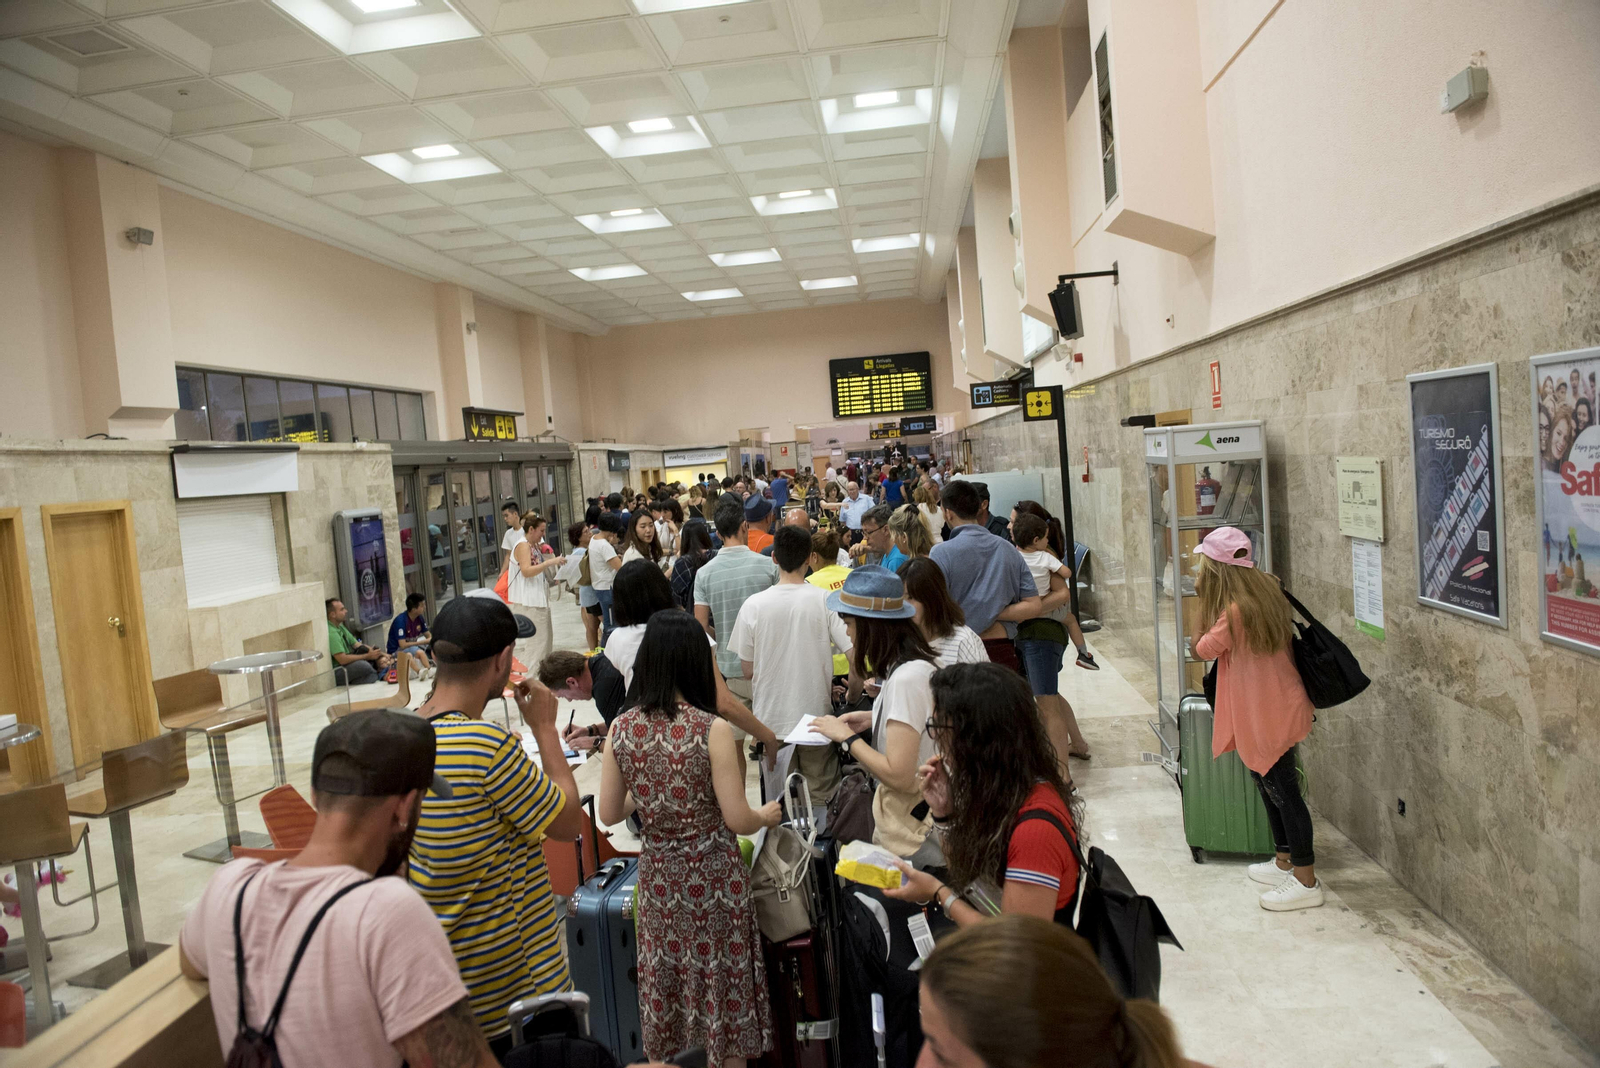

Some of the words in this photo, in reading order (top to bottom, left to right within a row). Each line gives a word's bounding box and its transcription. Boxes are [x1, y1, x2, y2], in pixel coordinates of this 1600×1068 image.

[481, 427, 495, 437] Salida
[1419, 428, 1455, 439] TURISMO
[1216, 436, 1240, 444] aena
[1435, 437, 1472, 449] SEGURO
[1574, 444, 1588, 452] Enjoy
[1467, 585, 1492, 595] Nacional
